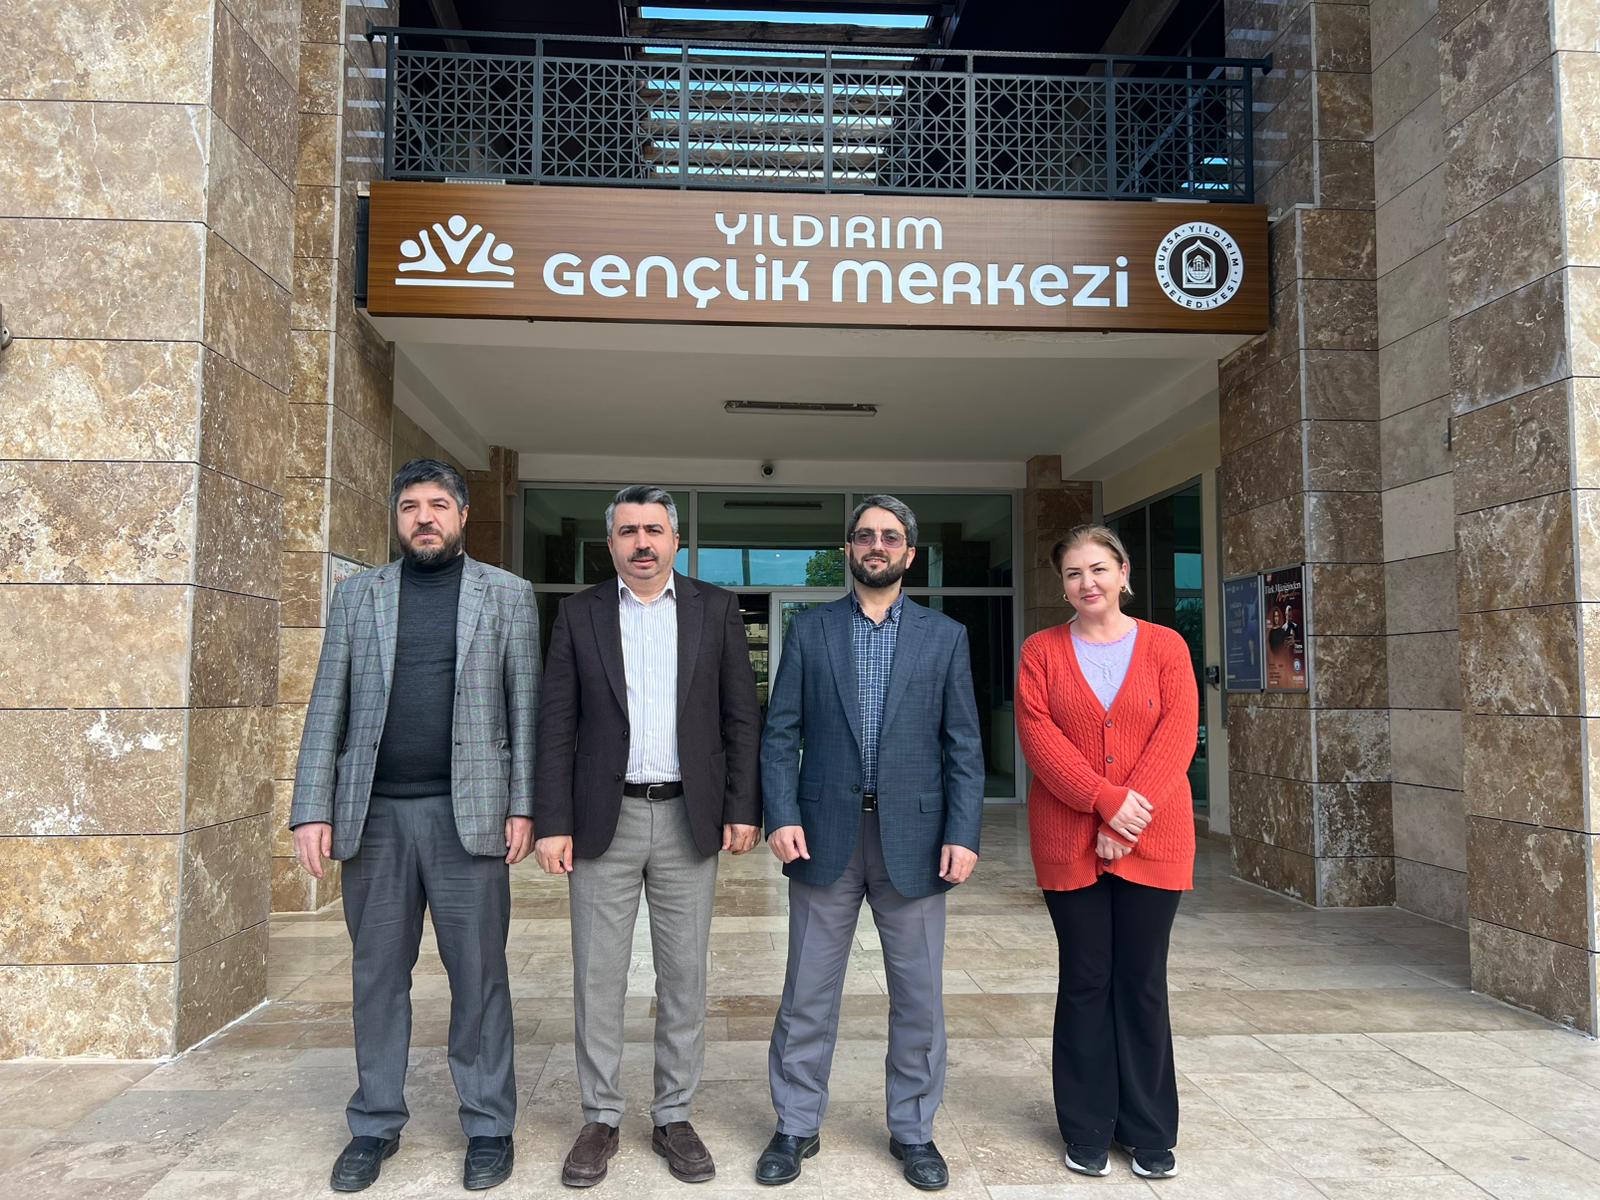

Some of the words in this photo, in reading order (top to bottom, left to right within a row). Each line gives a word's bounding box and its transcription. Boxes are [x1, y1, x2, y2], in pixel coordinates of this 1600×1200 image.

[714, 212, 943, 250] YILDIRIM
[1158, 232, 1181, 270] BURSA
[1188, 225, 1239, 267] YILDIRIM
